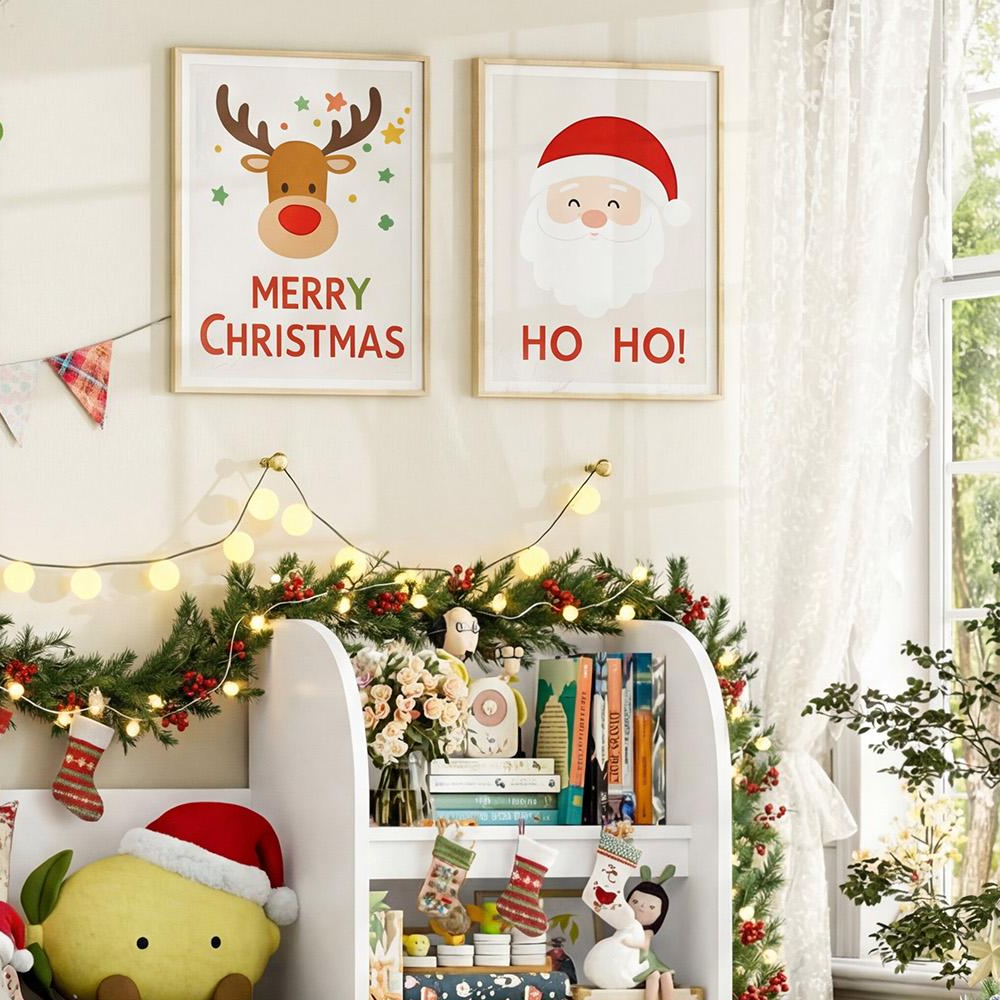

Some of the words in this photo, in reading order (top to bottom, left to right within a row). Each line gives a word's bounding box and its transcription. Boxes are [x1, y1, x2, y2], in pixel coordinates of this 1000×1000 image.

[252, 276, 371, 310] MERRY
[200, 313, 406, 360] CHRISTMAS
[521, 325, 583, 362] HO
[613, 327, 686, 364] HO!
